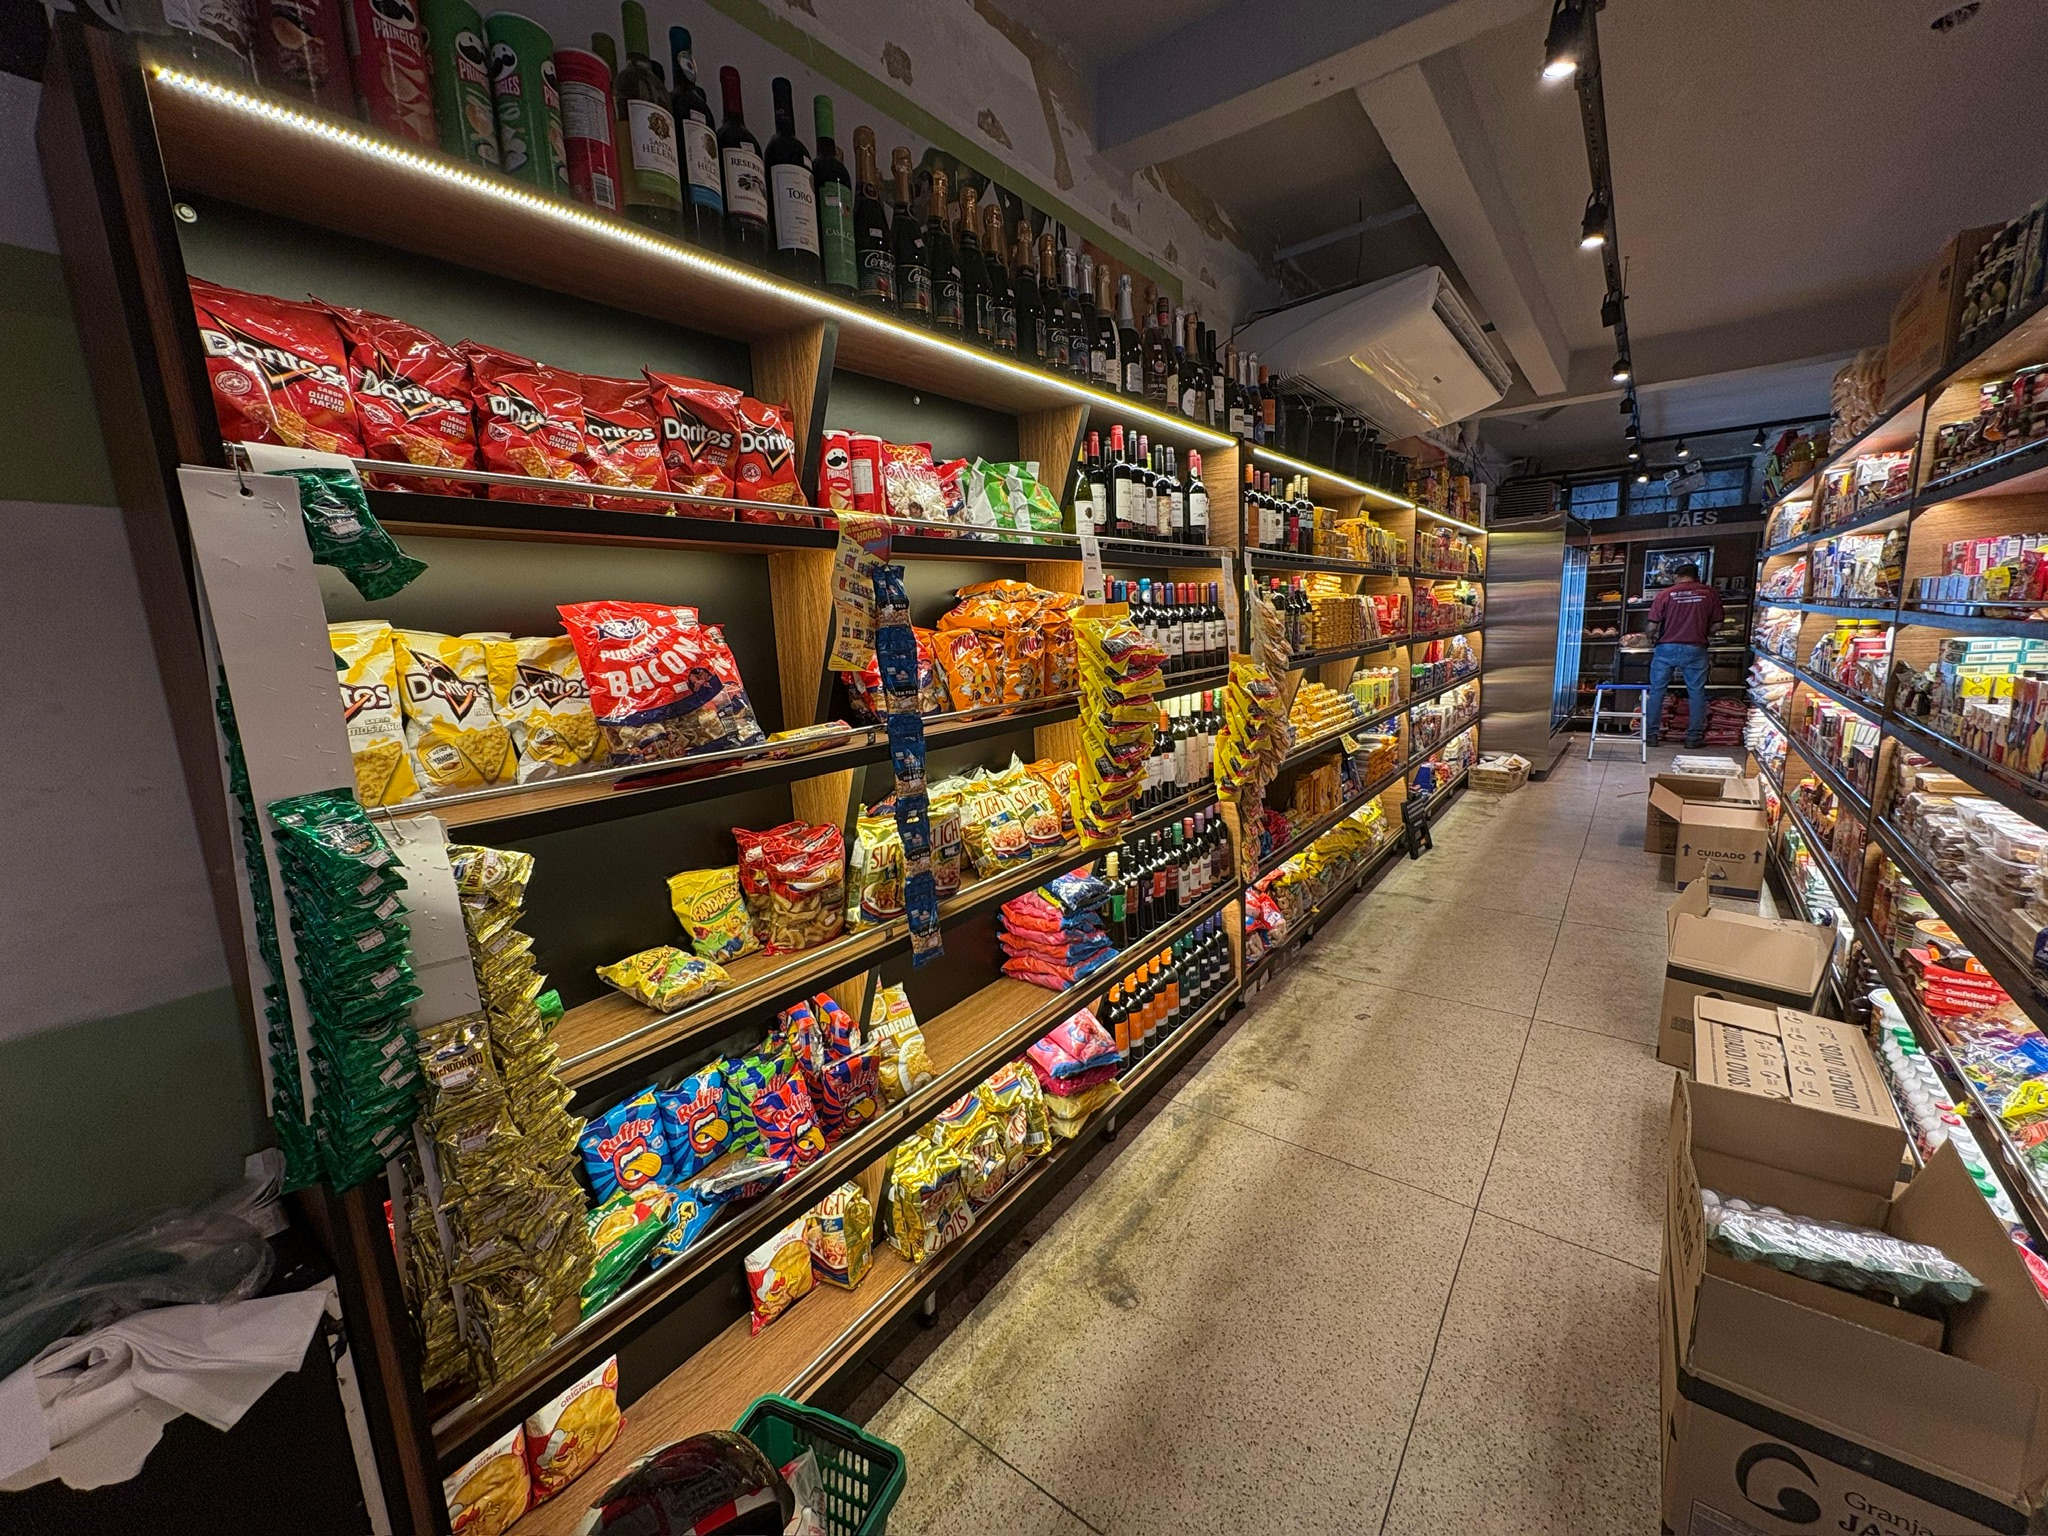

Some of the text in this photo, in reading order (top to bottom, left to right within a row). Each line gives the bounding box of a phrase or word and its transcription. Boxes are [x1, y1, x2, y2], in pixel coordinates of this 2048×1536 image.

[372, 17, 422, 58] PRINGLES
[786, 187, 812, 204] TORO
[201, 329, 349, 388] Doritos
[308, 391, 345, 407] QUEIJO
[317, 386, 343, 398] SABOR
[361, 369, 469, 414] Doritos
[309, 399, 345, 414] NACHO
[440, 419, 466, 433] QUEIJO
[447, 415, 467, 426] SABOR
[440, 426, 465, 440] NACHO
[549, 434, 578, 448] QUEIJO
[557, 431, 579, 442] SABOR
[584, 423, 655, 441] oritos
[663, 417, 733, 449] Doritos
[548, 441, 577, 453] NACHO
[827, 468, 850, 480] PRINGLES
[1667, 509, 1718, 527] PÃES
[857, 528, 882, 542] HORAS
[608, 636, 702, 697] BACON
[409, 671, 489, 701] Doritos
[510, 679, 591, 709] Doritos
[975, 794, 1006, 818] SLIGHT
[1697, 849, 1746, 861] CUIDADO
[1941, 976, 1994, 988] Confeiteiro
[1945, 988, 1998, 1002] Confeiteiro
[1726, 1061, 1751, 1088] OVOS.
[1818, 1043, 1861, 1112] UIDADO! OVOS.
[838, 1069, 877, 1100] Ruffles
[676, 1087, 723, 1124] Ruffles
[773, 1093, 812, 1131] Ruffles
[597, 1119, 654, 1162] Ruffles
[773, 1234, 797, 1252] ORIGINAL
[561, 1380, 594, 1408] ORIGINAL
[462, 1449, 502, 1483] ORIGINAL
[1844, 1491, 1934, 1536] Granja
